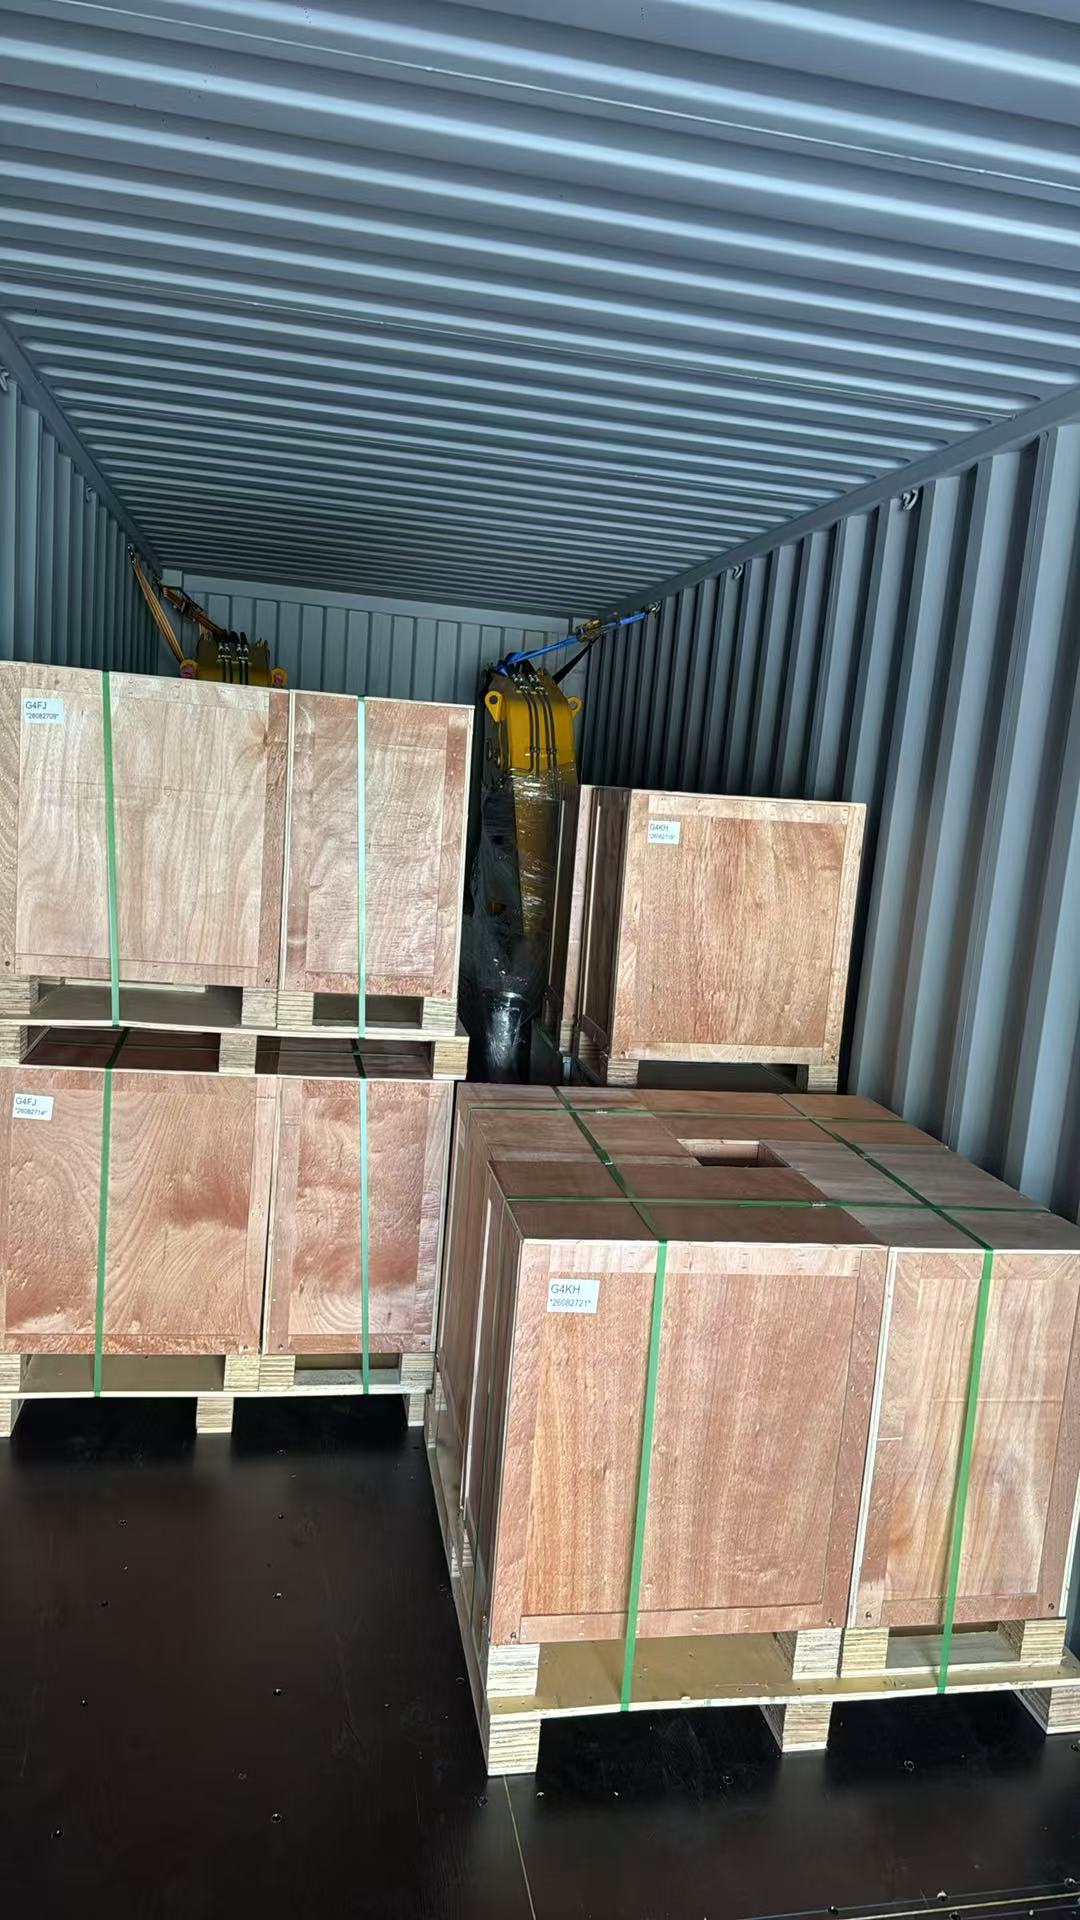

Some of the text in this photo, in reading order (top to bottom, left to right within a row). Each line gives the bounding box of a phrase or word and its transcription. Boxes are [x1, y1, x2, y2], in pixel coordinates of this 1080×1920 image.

[25, 701, 47, 710] G4FJ
[15, 1097, 37, 1106] G4FJ
[550, 1283, 581, 1294] G4KH
